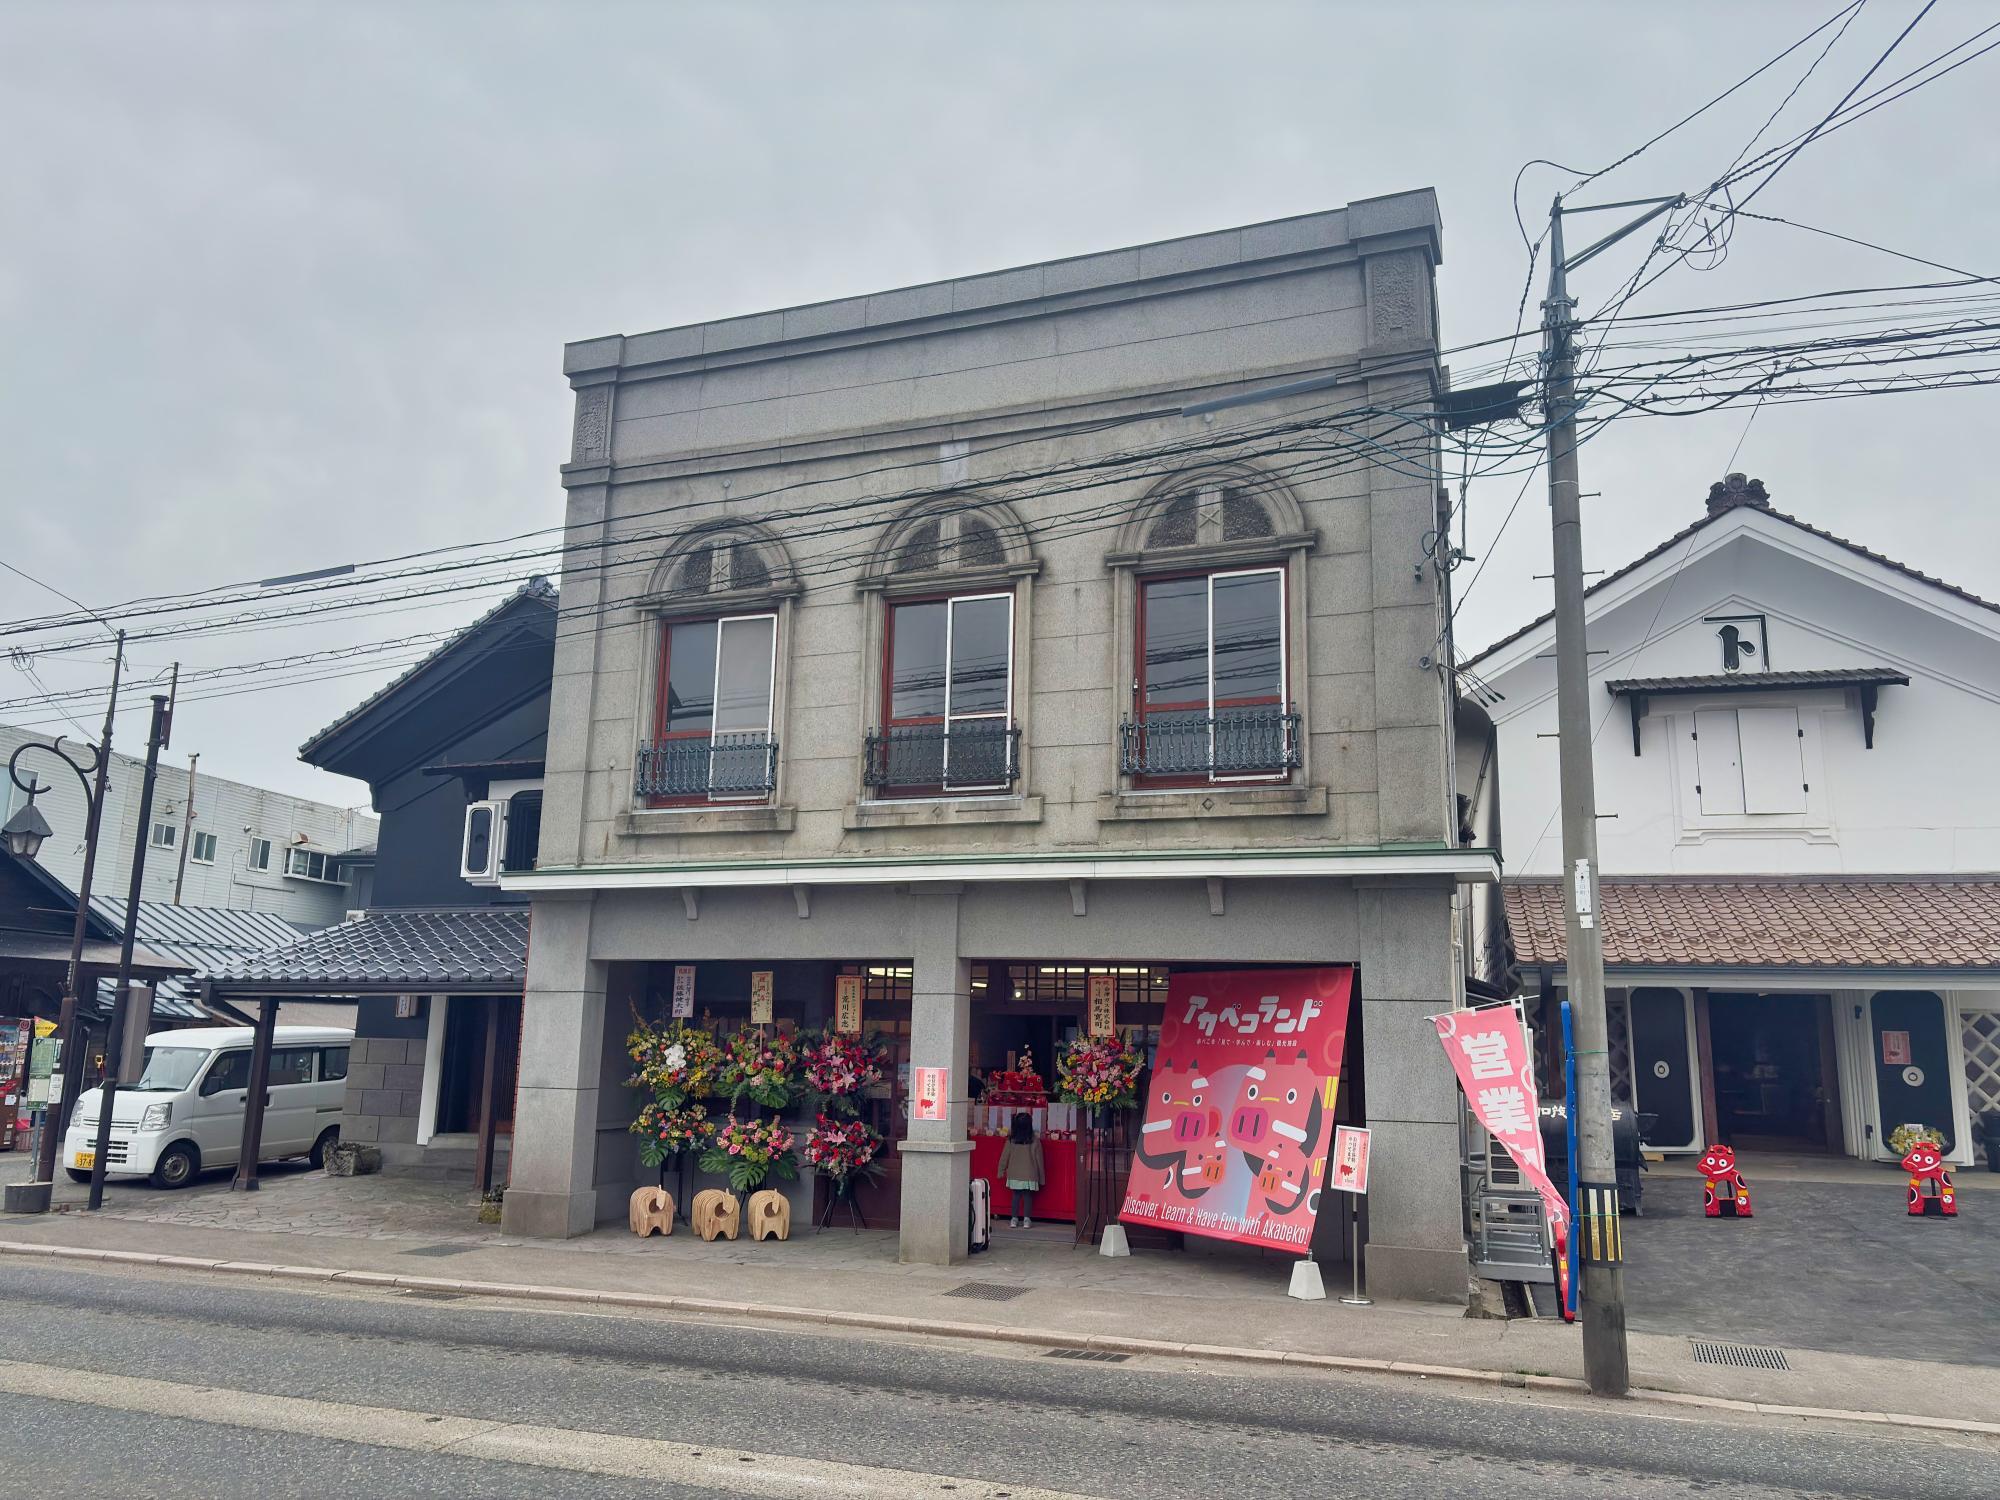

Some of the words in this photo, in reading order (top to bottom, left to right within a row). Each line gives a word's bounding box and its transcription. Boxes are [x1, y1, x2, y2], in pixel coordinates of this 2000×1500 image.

[1183, 995, 1324, 1037] アカベコランド
[1161, 1202, 1186, 1223] Learn
[1187, 1208, 1194, 1224] &
[1195, 1210, 1218, 1229] Have
[1219, 1214, 1236, 1232] Fun
[1238, 1216, 1261, 1236] with
[1261, 1220, 1311, 1245] Akabeko!
